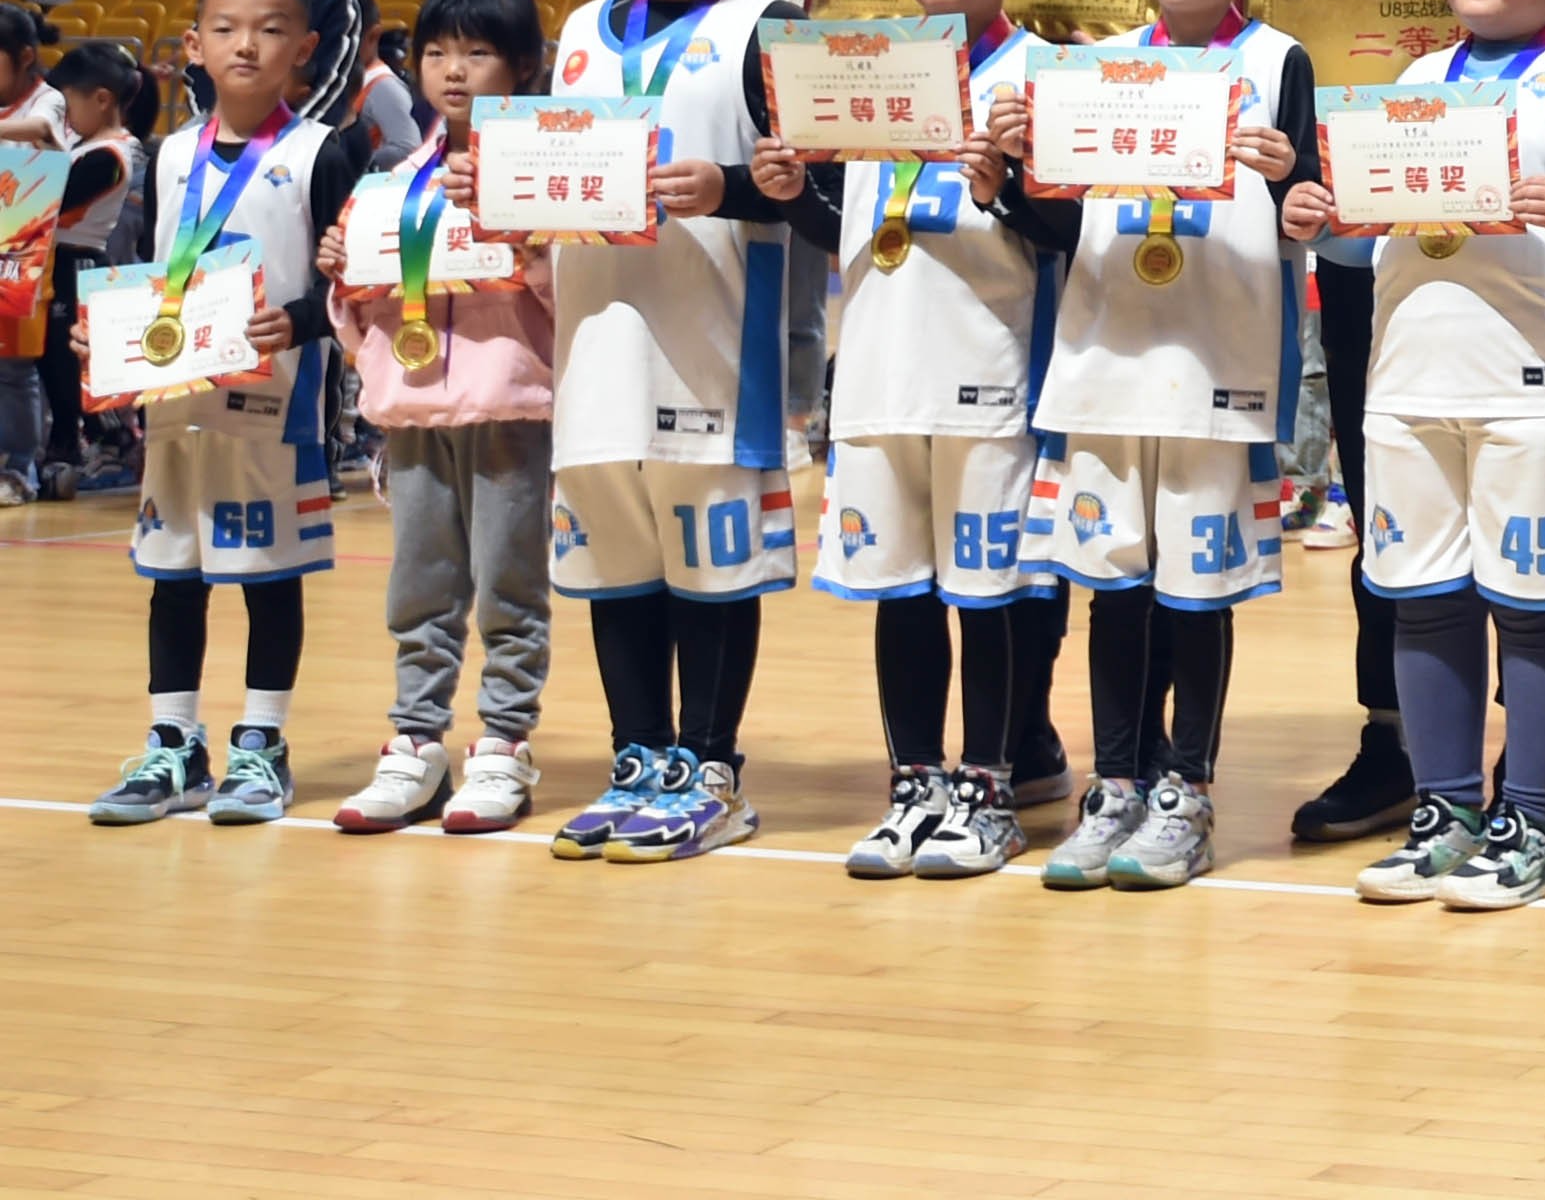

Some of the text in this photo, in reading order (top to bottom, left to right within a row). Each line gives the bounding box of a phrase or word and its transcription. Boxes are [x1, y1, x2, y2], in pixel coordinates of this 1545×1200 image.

[813, 96, 914, 123] 二等奖
[1072, 127, 1178, 156] 二等奖
[513, 175, 604, 202] 二等奖
[1369, 164, 1467, 194] 二等奖
[379, 227, 471, 254] 二奖
[124, 324, 213, 363] 二奖
[212, 500, 275, 549] 69
[673, 499, 750, 568] 10
[954, 509, 1020, 571] 85
